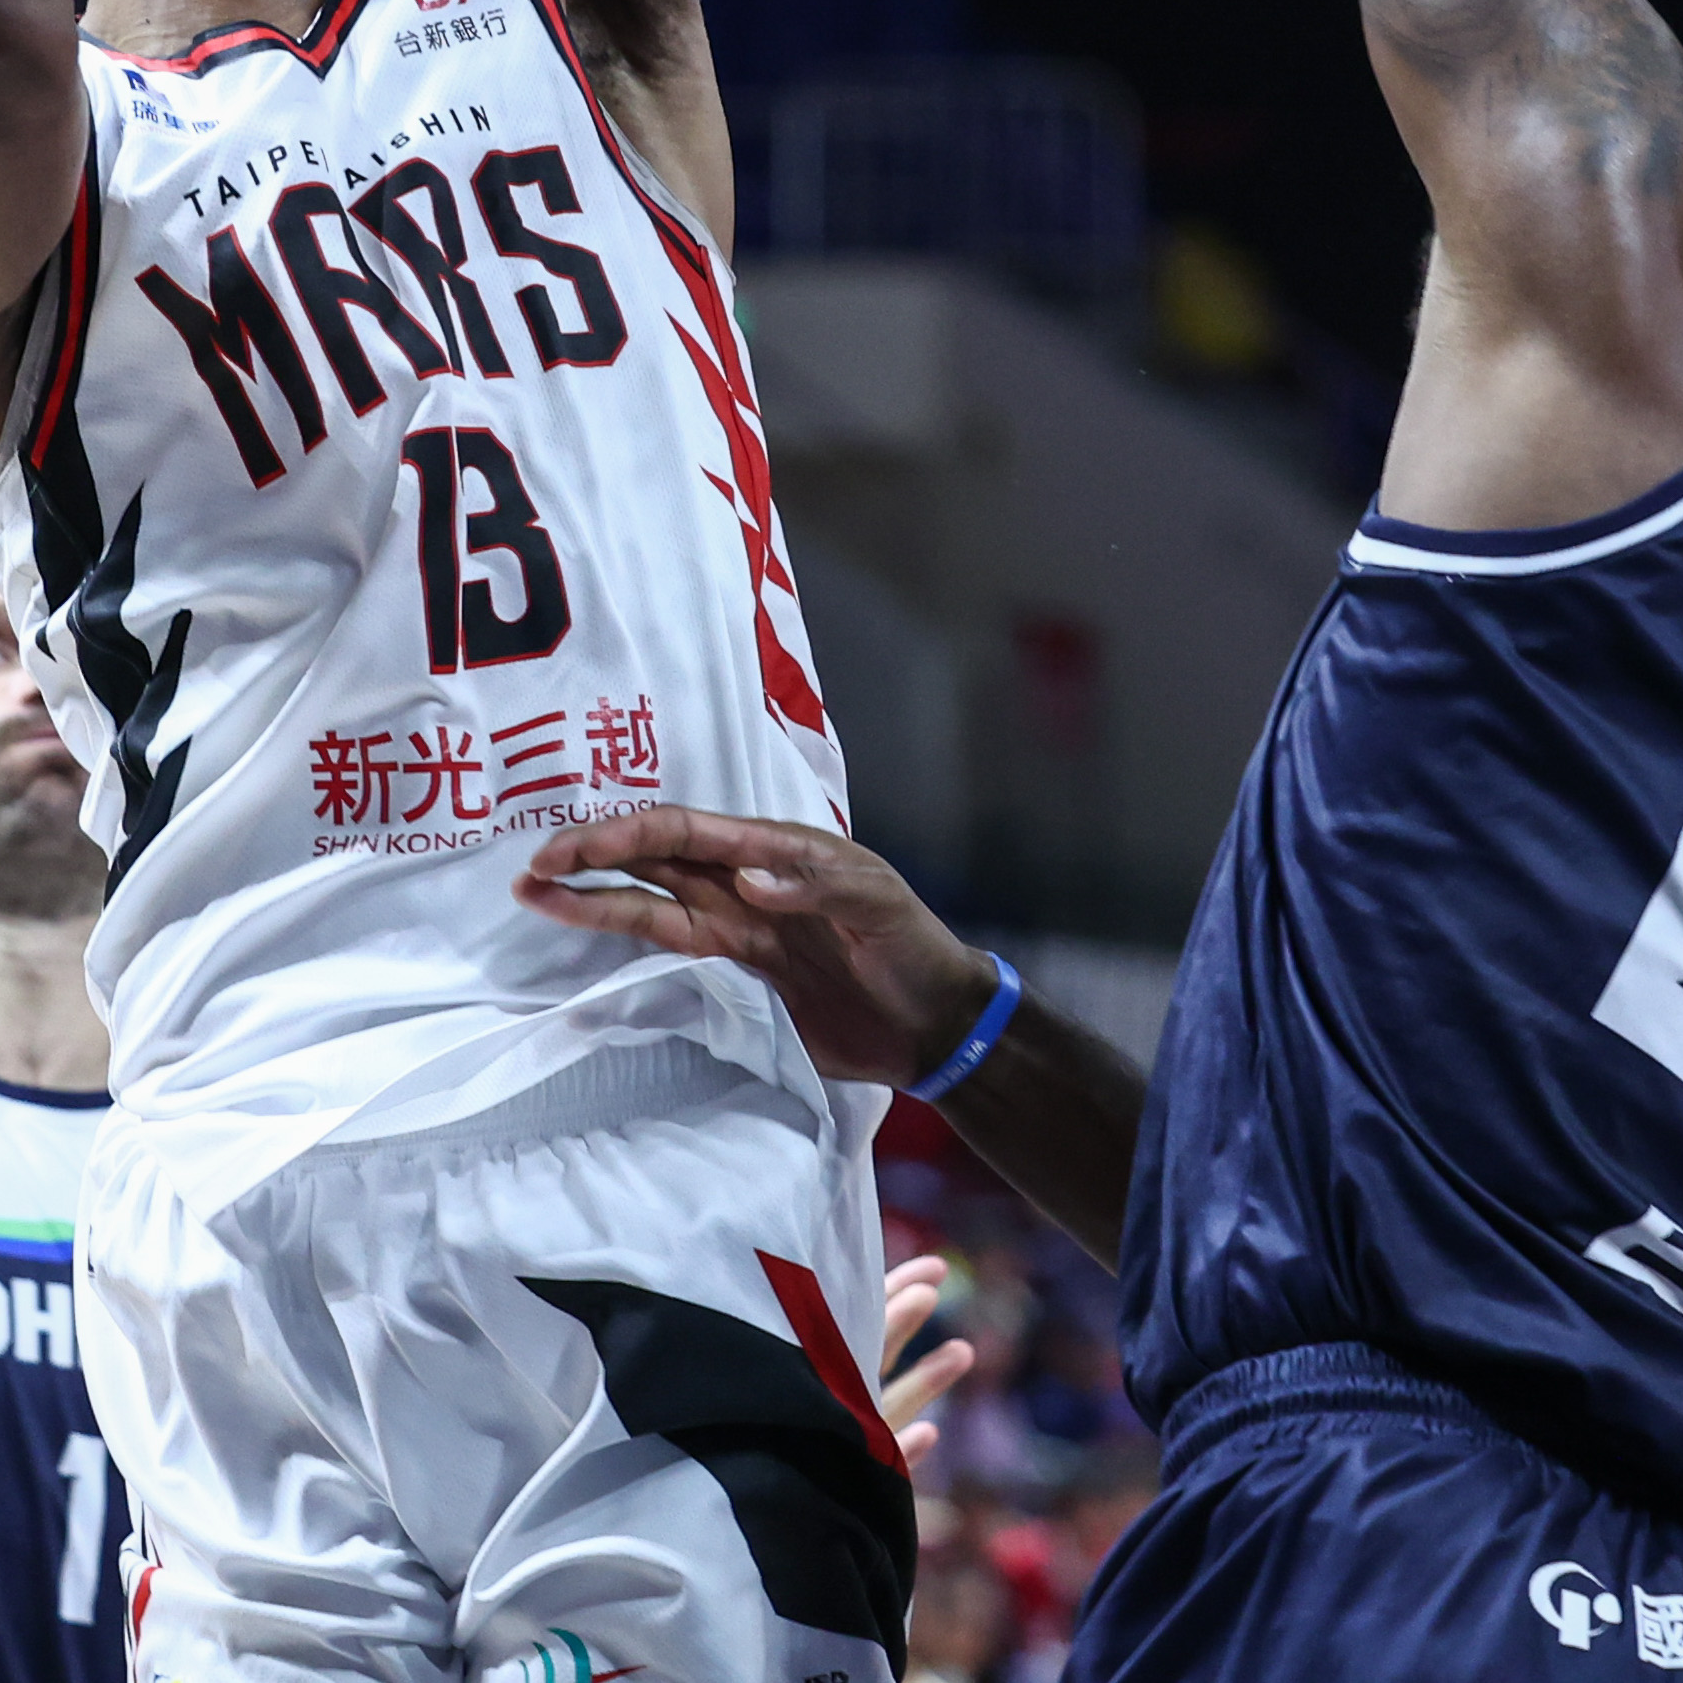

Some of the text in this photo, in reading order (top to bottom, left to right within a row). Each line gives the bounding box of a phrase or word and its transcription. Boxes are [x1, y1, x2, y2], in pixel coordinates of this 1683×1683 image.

[394, 8, 507, 58] 台新銀行
[344, 104, 492, 190] AISHIN
[134, 144, 627, 490] MARS
[399, 426, 572, 675] 13
[308, 693, 662, 826] 新光三越
[385, 829, 483, 855] KONG
[492, 799, 658, 838] MITSUKOS
